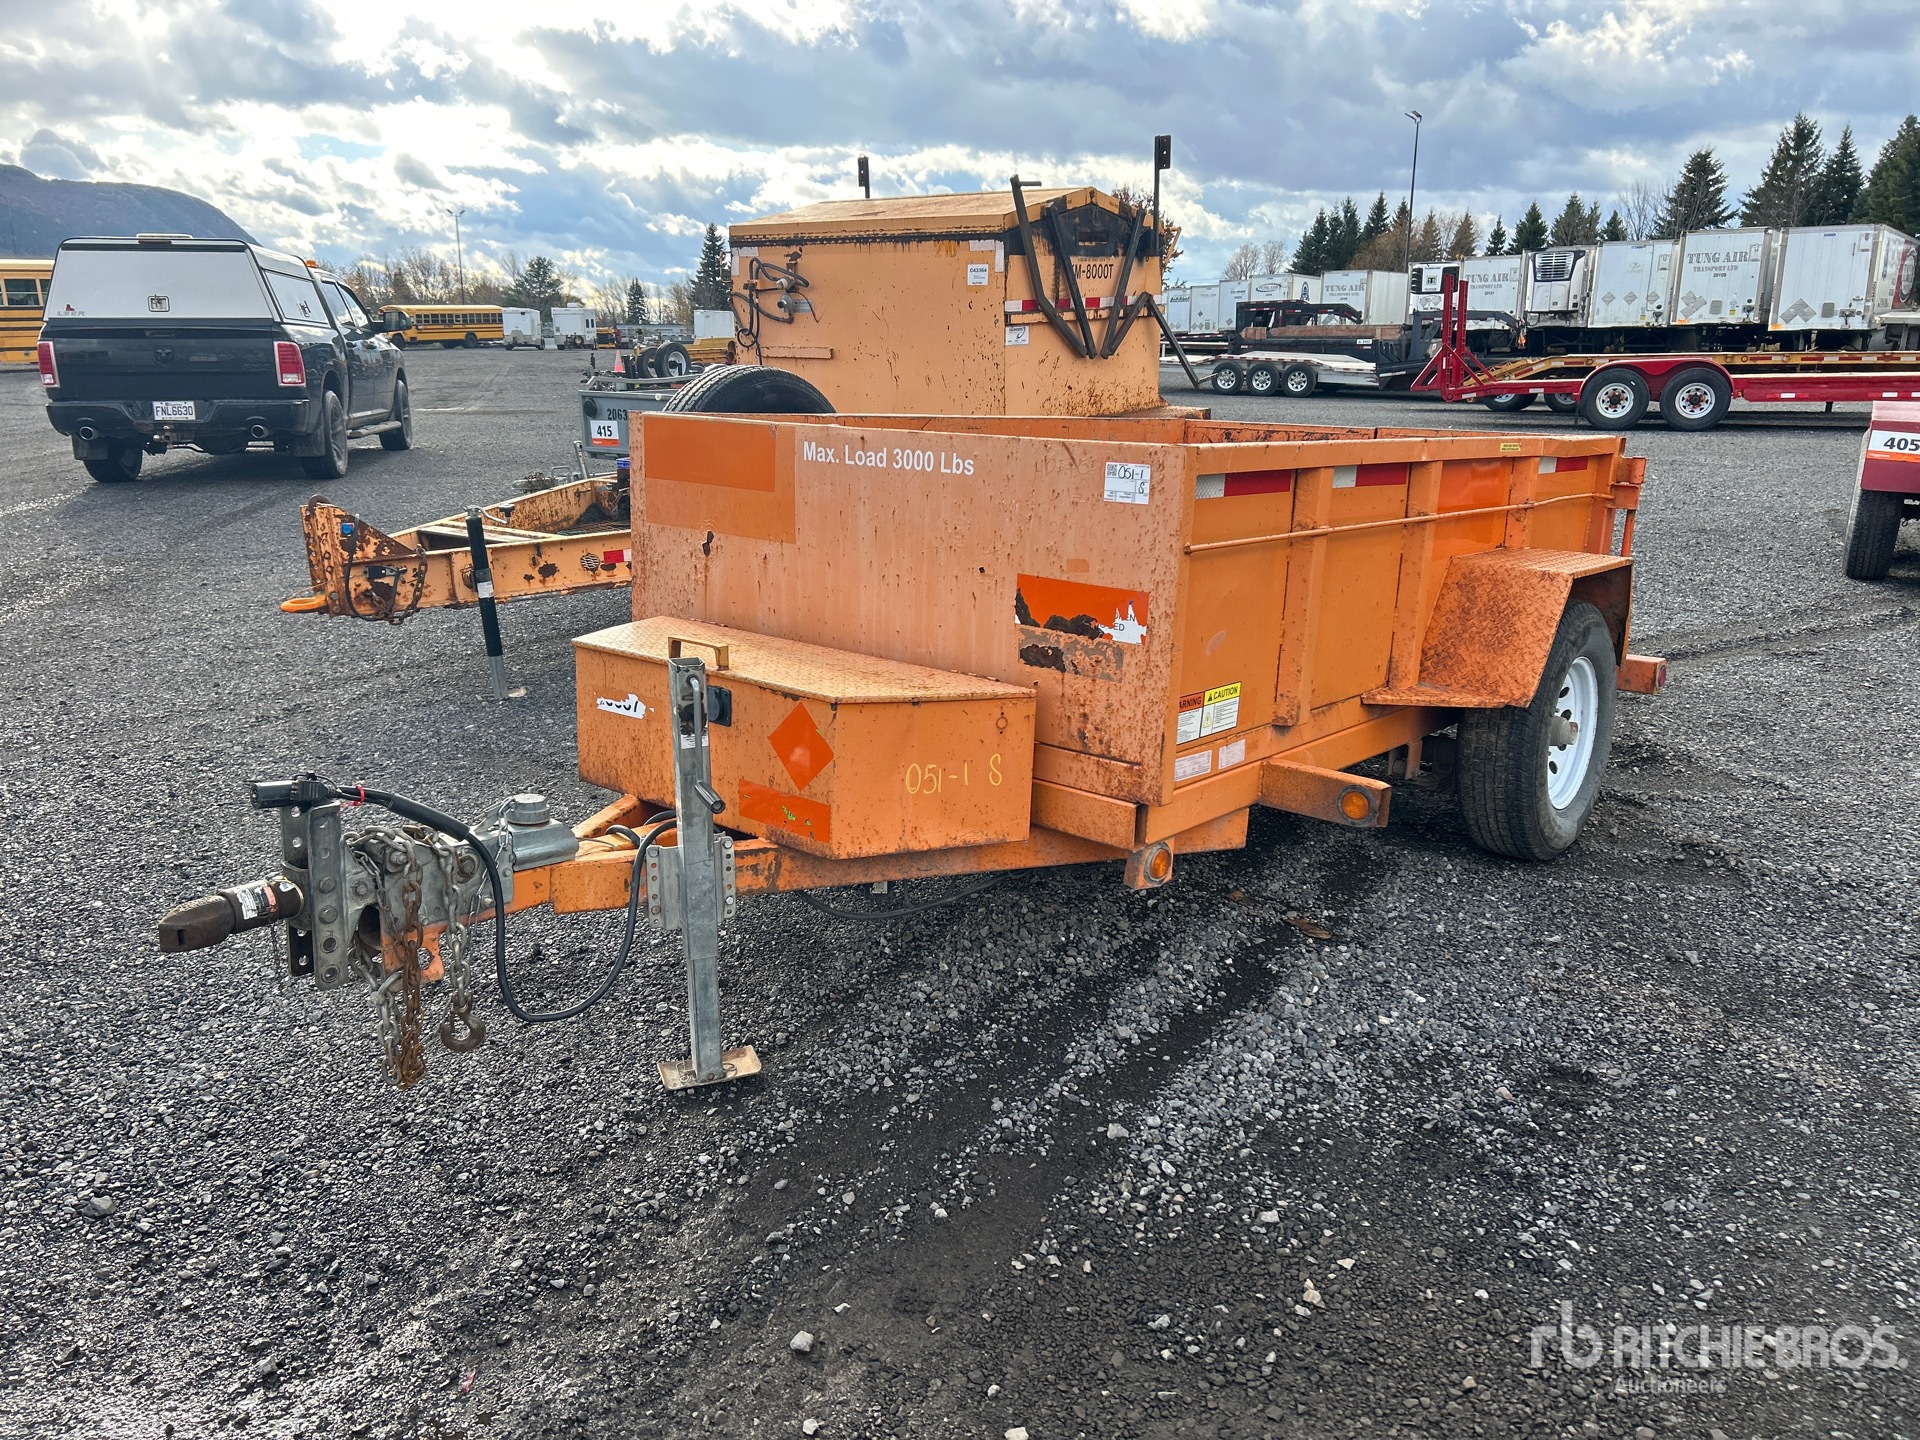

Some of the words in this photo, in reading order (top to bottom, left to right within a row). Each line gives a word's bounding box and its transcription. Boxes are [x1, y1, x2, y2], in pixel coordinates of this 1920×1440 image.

[1687, 252, 1721, 264] TUNG
[1722, 251, 1748, 263] AIR
[1072, 263, 1114, 280] M-8000T
[1465, 274, 1489, 283] TUNG
[1490, 273, 1509, 282] AIR
[155, 405, 194, 417] FNL6630
[606, 408, 628, 421] 2063
[596, 425, 613, 437] 415
[1883, 437, 1920, 452] 405
[803, 441, 839, 464] Max.
[844, 444, 887, 468] Load
[892, 448, 934, 472] 3000
[940, 451, 975, 476] Lbs
[1213, 685, 1238, 700] CAUTION
[1179, 696, 1202, 709] ARNING
